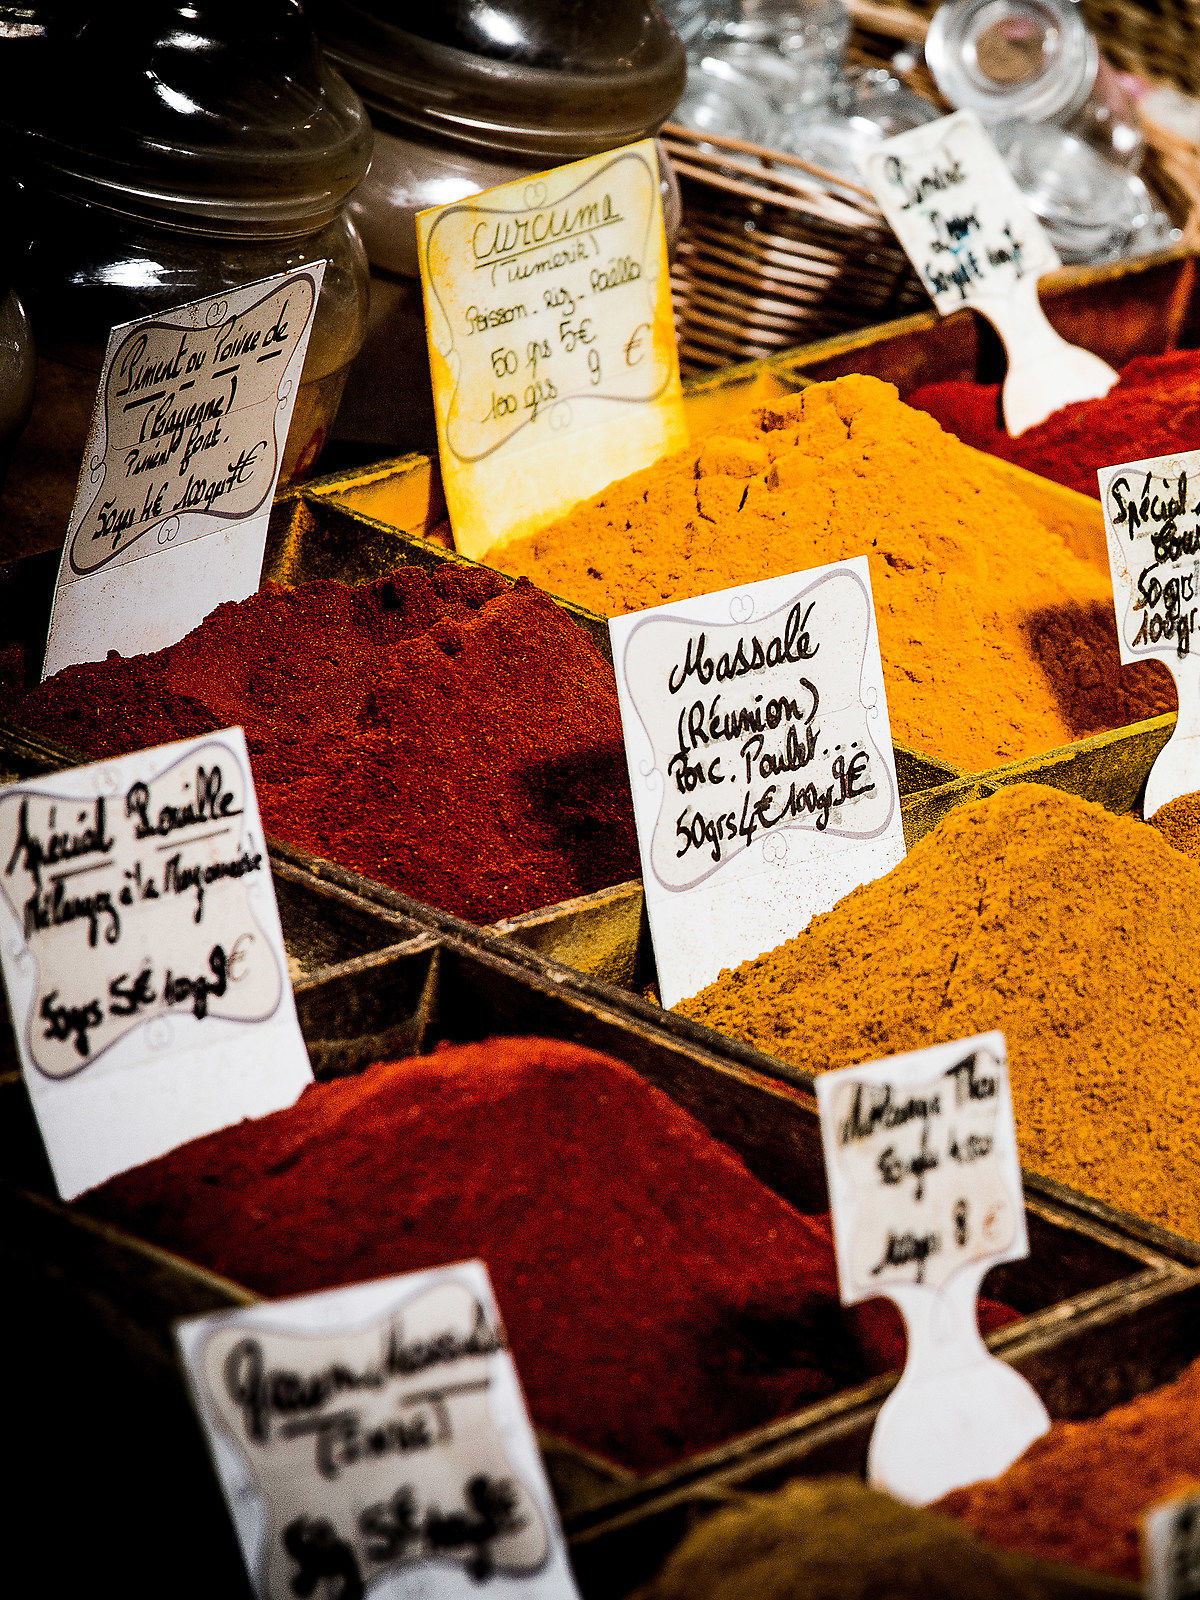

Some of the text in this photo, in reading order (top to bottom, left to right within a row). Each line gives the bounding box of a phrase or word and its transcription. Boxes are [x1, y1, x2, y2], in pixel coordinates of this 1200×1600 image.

[472, 193, 621, 260] Curcuma
[116, 334, 188, 397] Piment
[211, 316, 260, 373] Poivre
[261, 300, 289, 351] de
[1112, 471, 1187, 540] Spécial
[668, 601, 820, 694] Massalé
[678, 677, 820, 751] (Réunion)
[676, 807, 738, 862] 50grs
